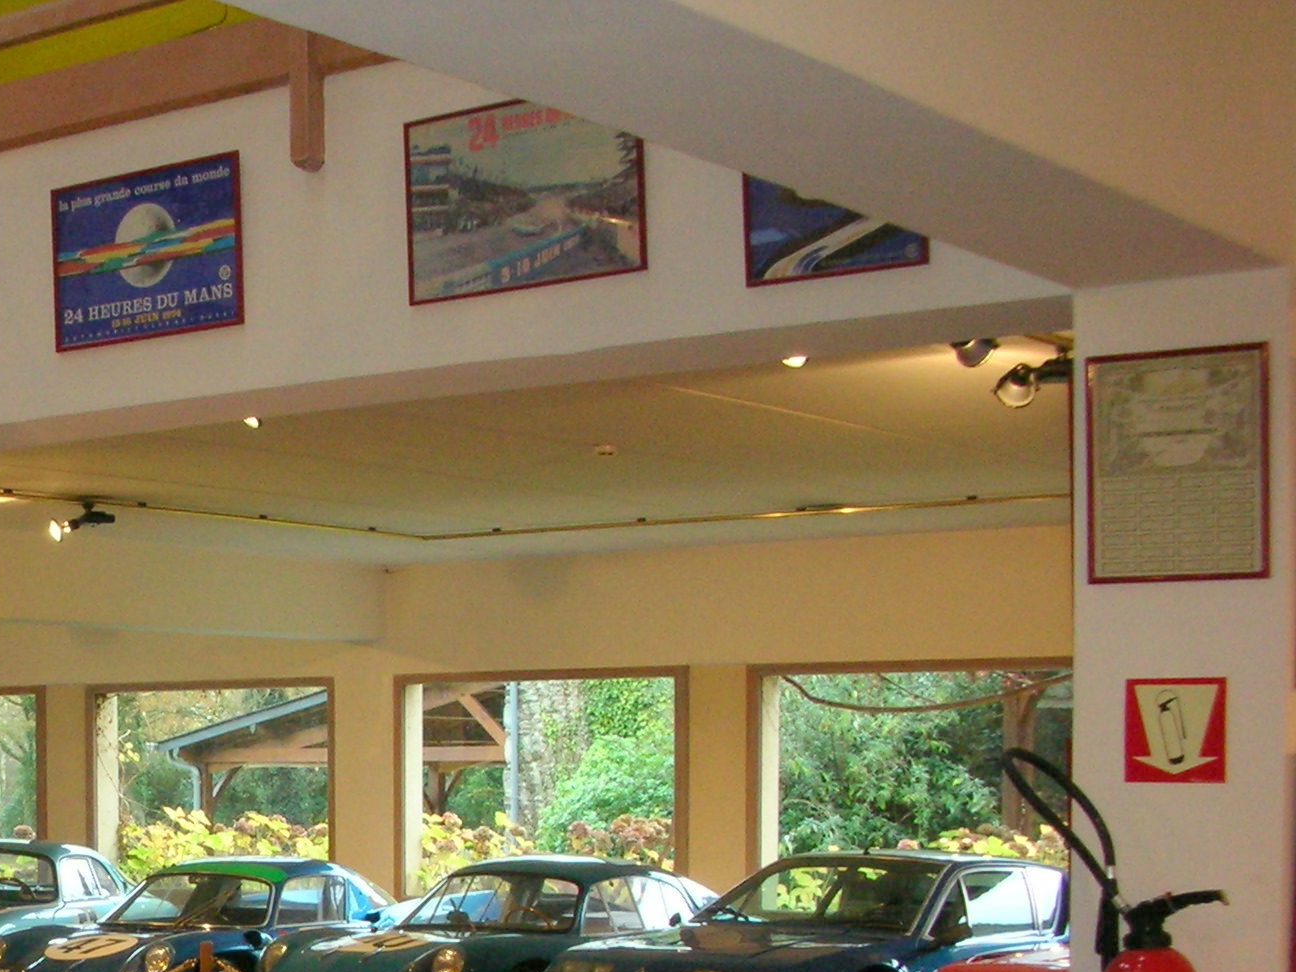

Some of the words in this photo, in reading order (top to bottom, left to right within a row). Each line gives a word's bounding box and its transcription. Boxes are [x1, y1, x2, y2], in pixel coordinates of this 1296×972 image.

[94, 187, 131, 207] grande
[134, 179, 171, 196] course
[191, 165, 231, 183] monde
[64, 308, 84, 325] 24
[88, 296, 153, 321] HEURES
[157, 291, 179, 308] DU
[184, 282, 233, 305] MANS
